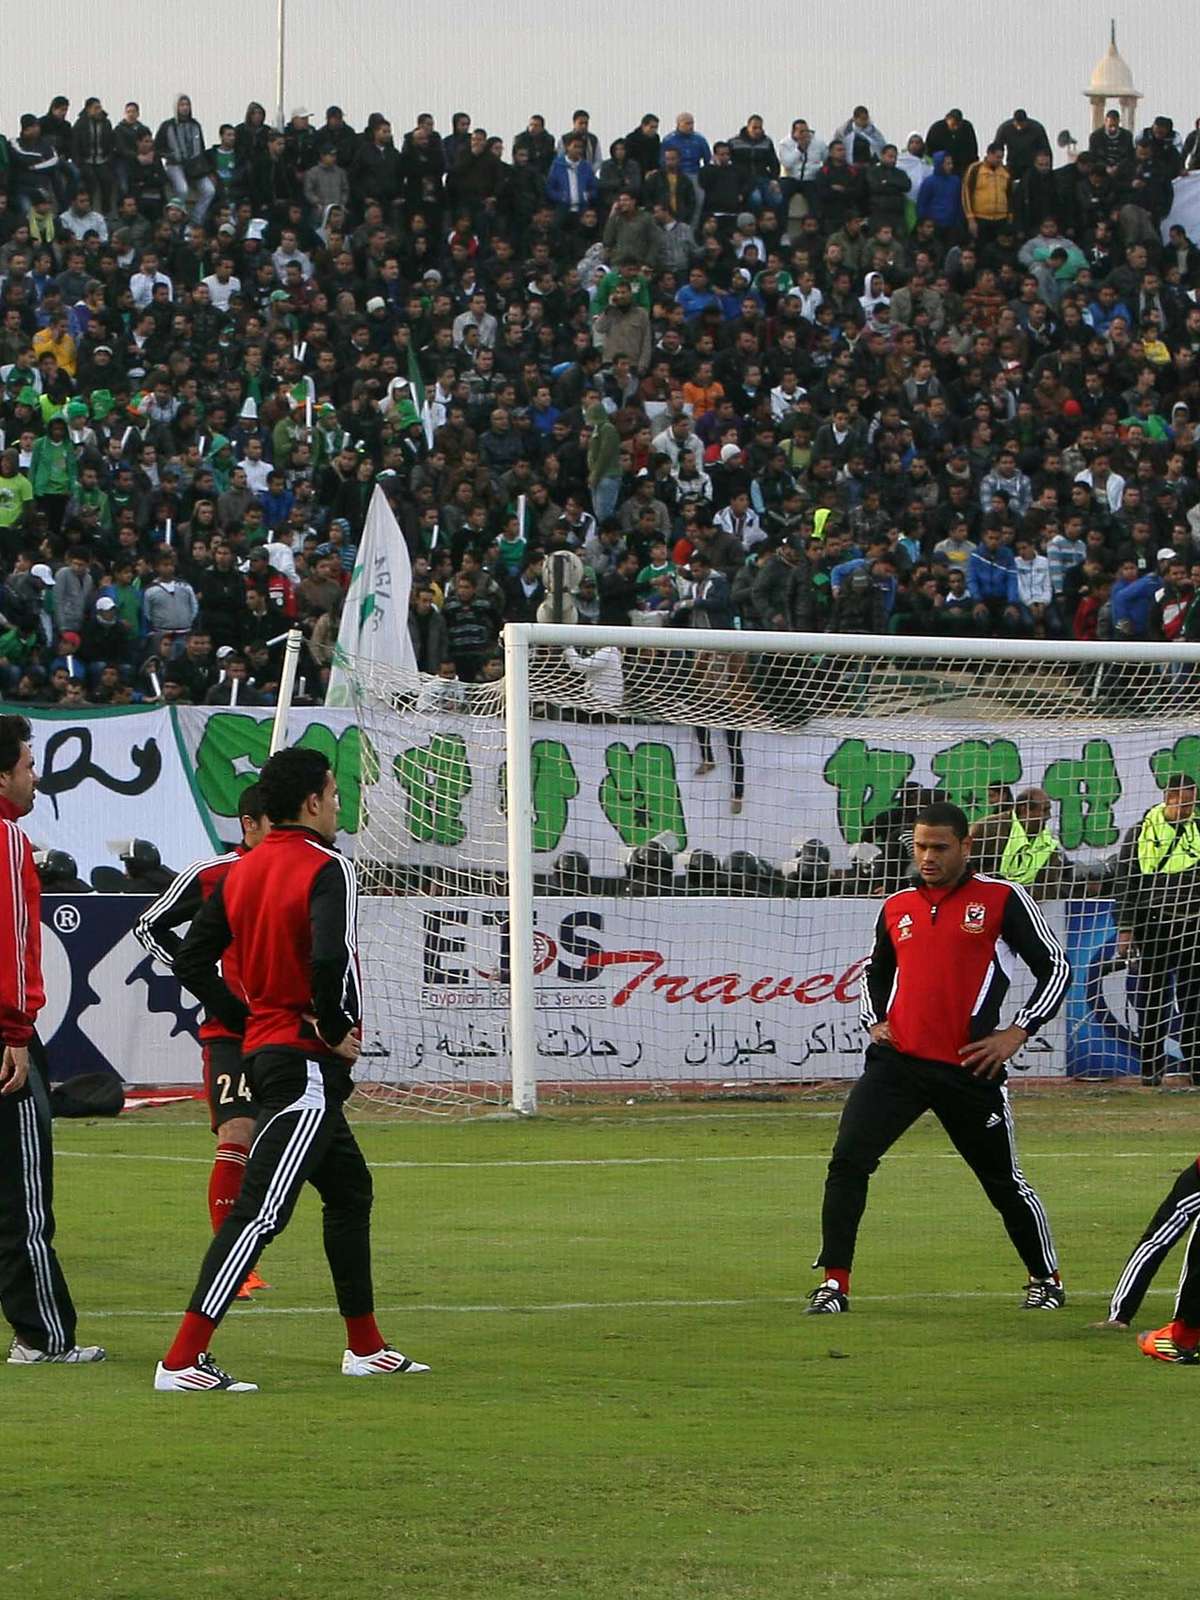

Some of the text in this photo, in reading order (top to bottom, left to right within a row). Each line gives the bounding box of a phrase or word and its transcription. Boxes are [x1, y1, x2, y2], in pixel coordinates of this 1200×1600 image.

[553, 991, 607, 1006] Service
[582, 950, 872, 1008] Travel
[684, 1020, 777, 1067] طيران
[216, 1072, 253, 1105] 24
